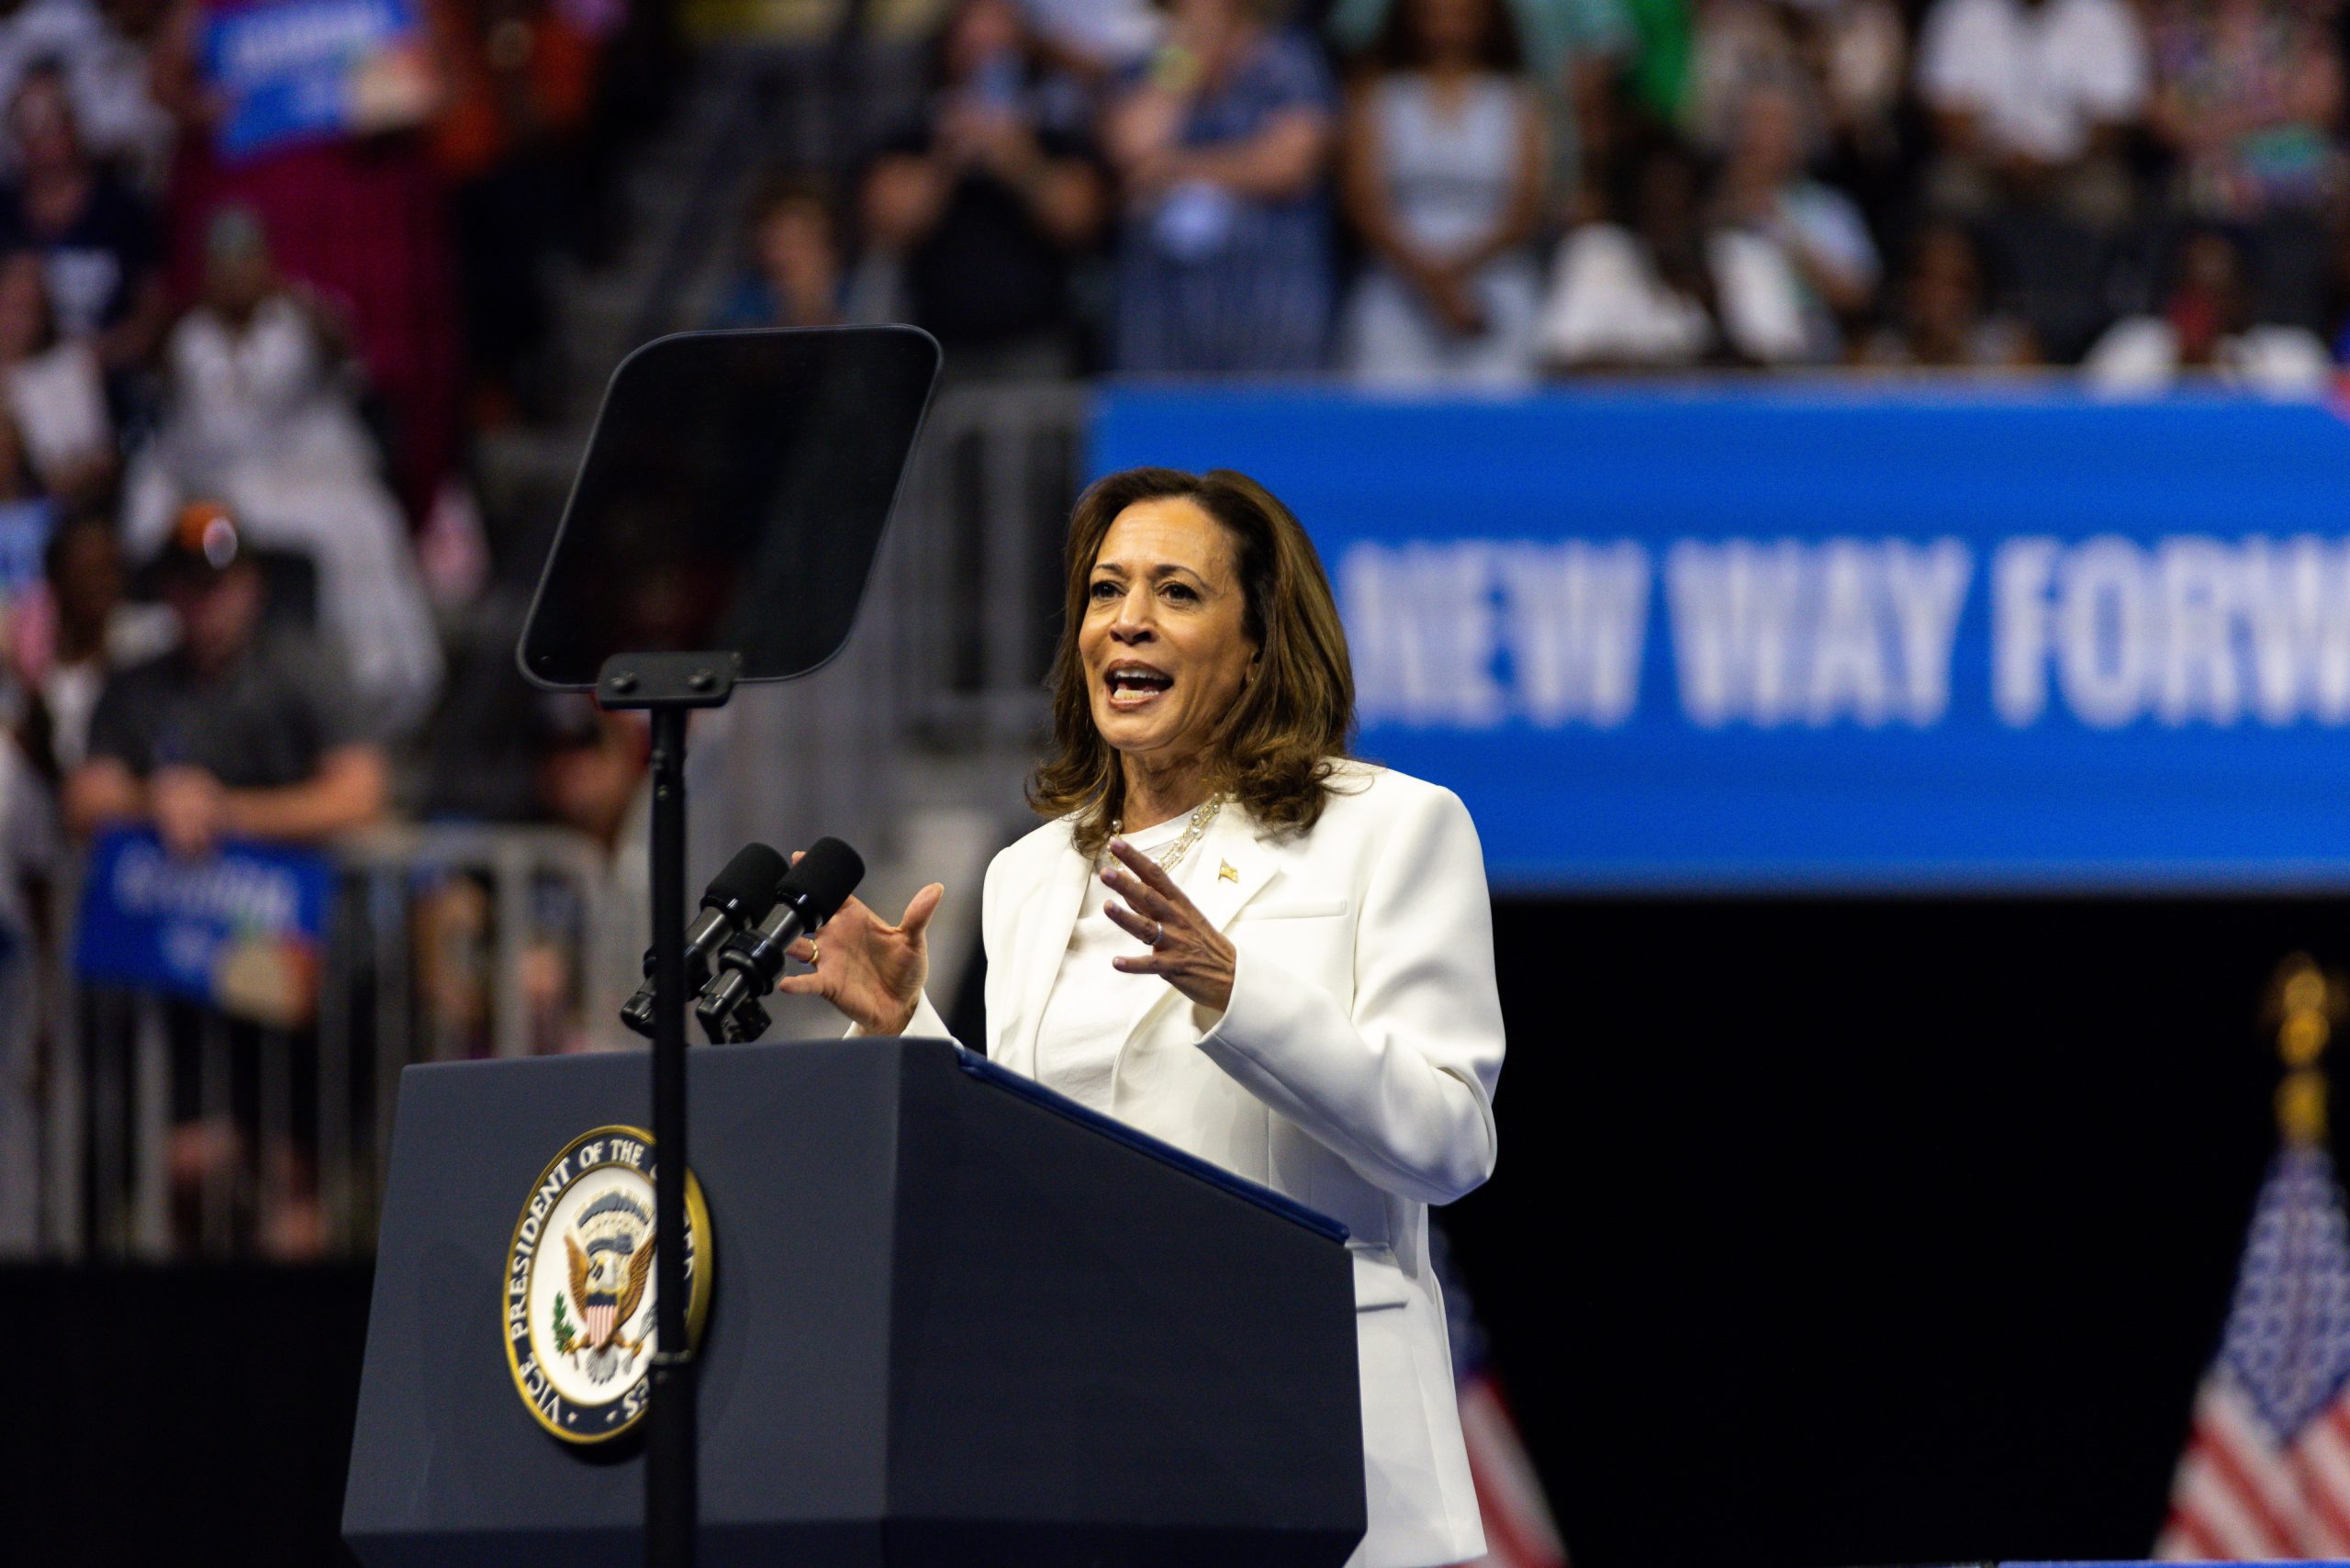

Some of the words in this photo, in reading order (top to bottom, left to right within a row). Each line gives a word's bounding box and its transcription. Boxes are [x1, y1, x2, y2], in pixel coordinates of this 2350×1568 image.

[1337, 538, 1650, 729] NEW
[1665, 537, 1972, 729] WAY
[578, 1140, 605, 1170] OF
[610, 1138, 644, 1168] THE
[509, 1157, 571, 1342] PRESIDENT
[518, 1351, 560, 1424] VICE
